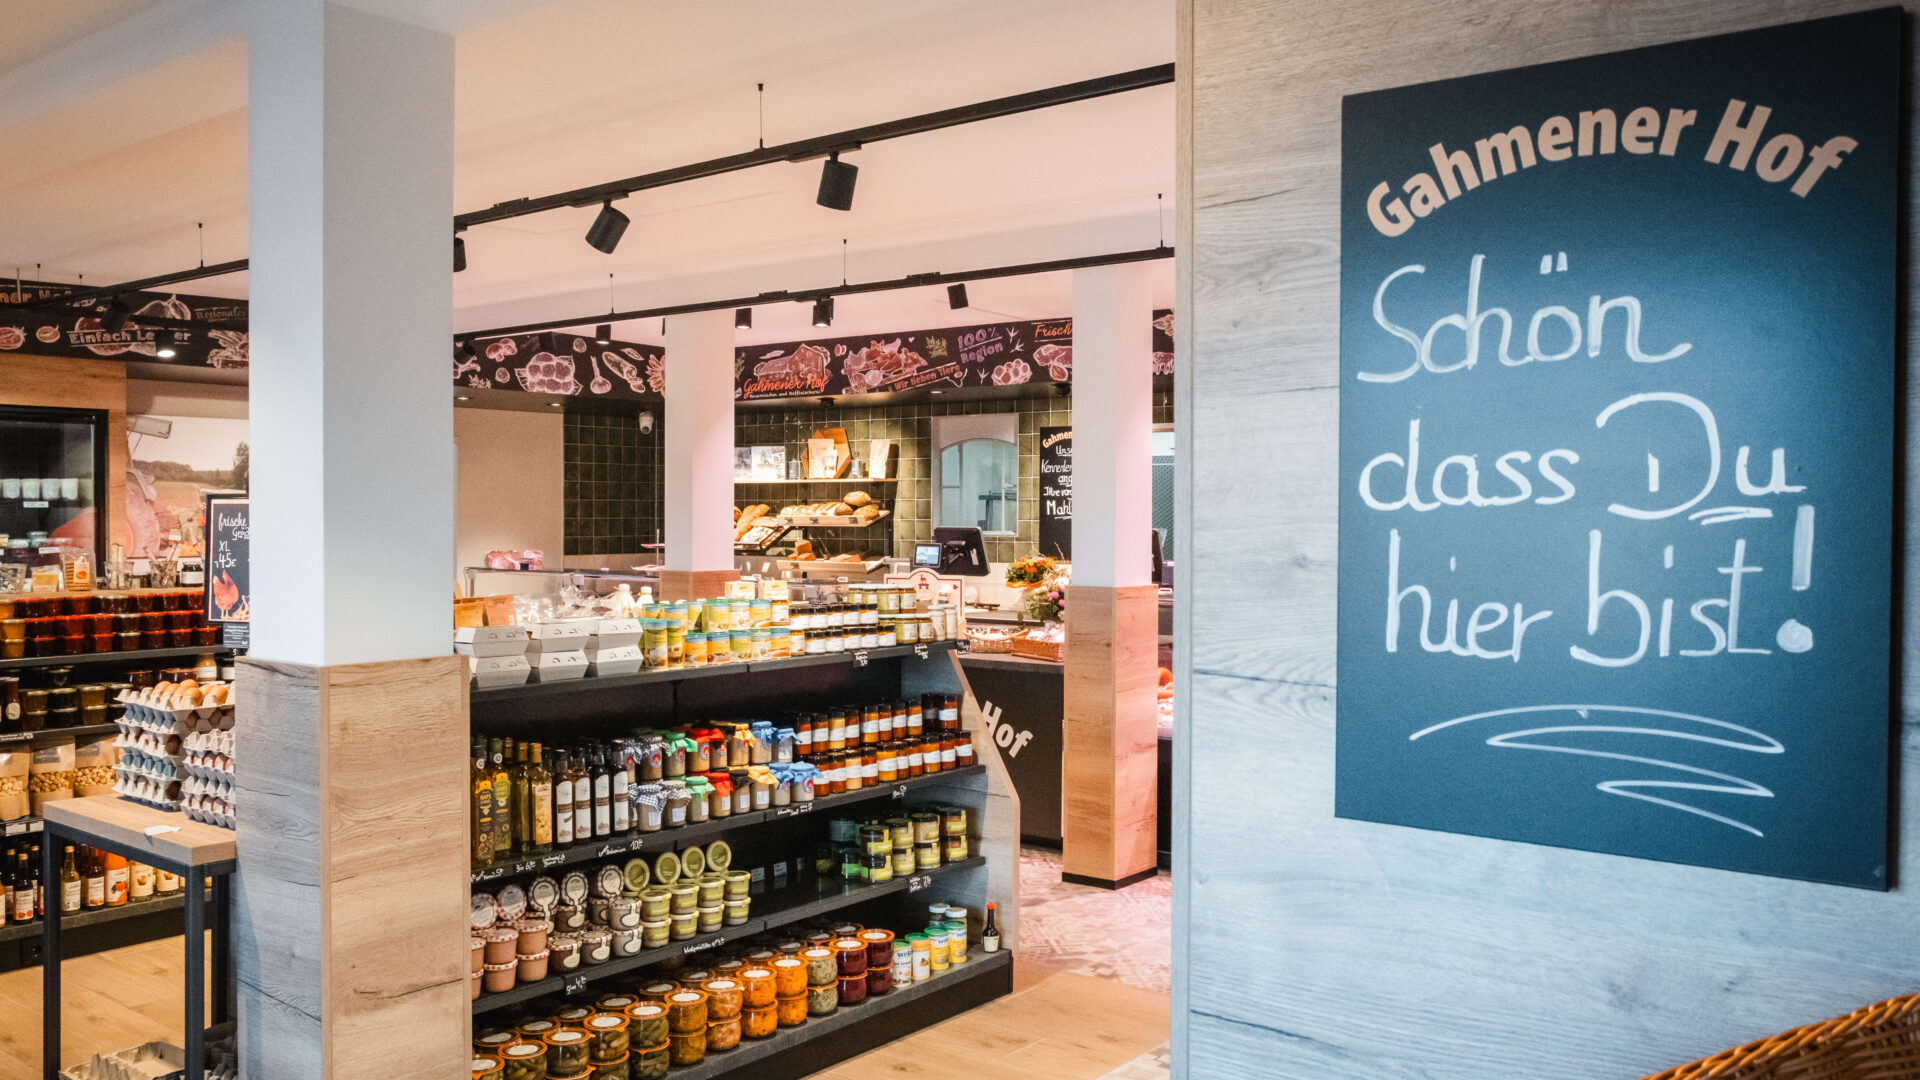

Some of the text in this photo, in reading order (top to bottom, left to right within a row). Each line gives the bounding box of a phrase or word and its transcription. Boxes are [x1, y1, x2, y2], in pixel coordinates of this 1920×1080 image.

[1367, 99, 1858, 236] Gahmener Hof
[1357, 252, 1692, 382] Schön
[69, 330, 191, 344] Einfach Leer
[957, 327, 999, 349] 100%
[960, 341, 1003, 363] Region
[743, 375, 830, 399] Gahmener Hof
[894, 380, 909, 390] Wir
[910, 372, 937, 384] lieben
[1358, 392, 1807, 519] dass Du
[218, 512, 247, 531] frische
[219, 541, 231, 552] XL
[1386, 505, 1814, 666] hier bist!
[982, 700, 1034, 758] Hof
